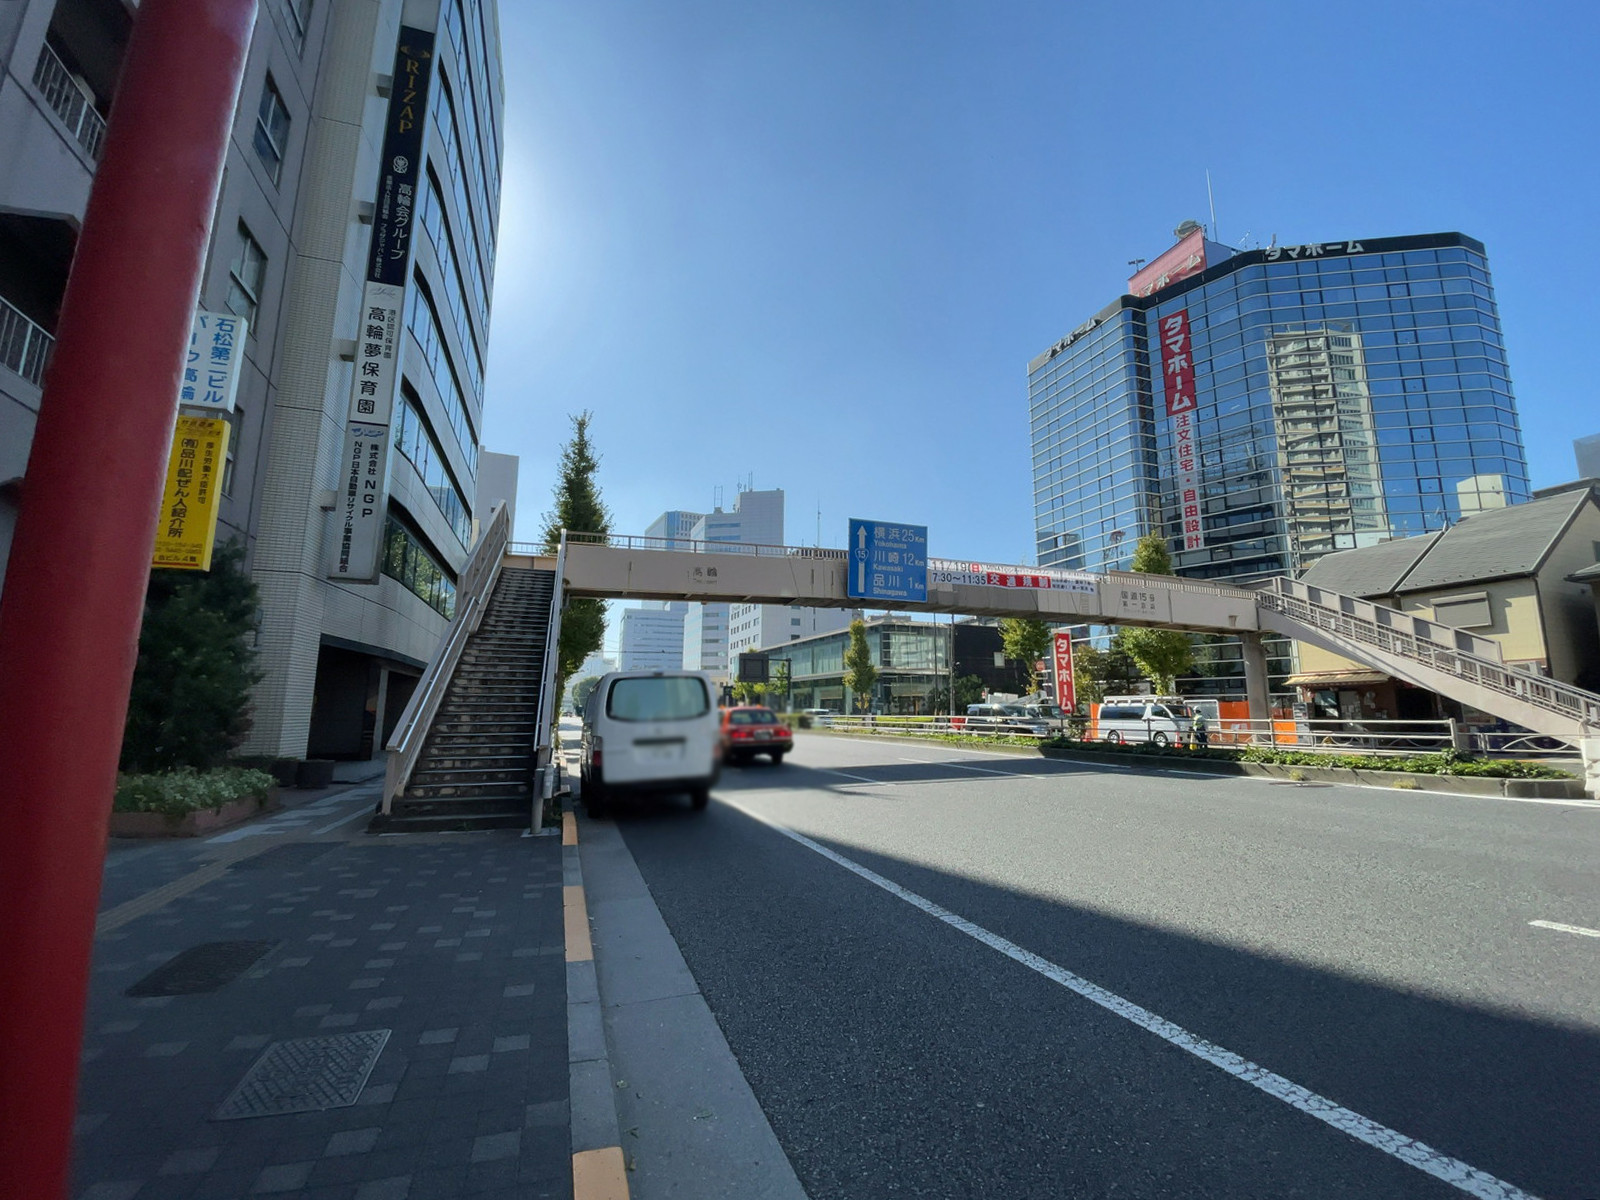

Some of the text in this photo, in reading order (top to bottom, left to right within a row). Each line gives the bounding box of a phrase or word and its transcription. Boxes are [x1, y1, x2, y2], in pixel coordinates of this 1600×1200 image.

[400, 59, 420, 134] RIZAP
[390, 183, 412, 260] 高輪会グループ
[1265, 240, 1364, 260] タマホーム
[1130, 254, 1201, 298] マホーム
[203, 317, 237, 403] 石松第二ビル
[357, 306, 386, 414] 高輪夢保育園
[1164, 314, 1192, 413] タマホーム
[1175, 415, 1202, 550] 注文住宅・自由設計
[858, 551, 866, 559] 15
[873, 563, 903, 572] Kawasaki
[874, 540, 907, 549] Yokohama
[873, 573, 900, 588] 品川
[873, 587, 907, 597] Shinagawa
[1056, 637, 1073, 713] タマホーム
